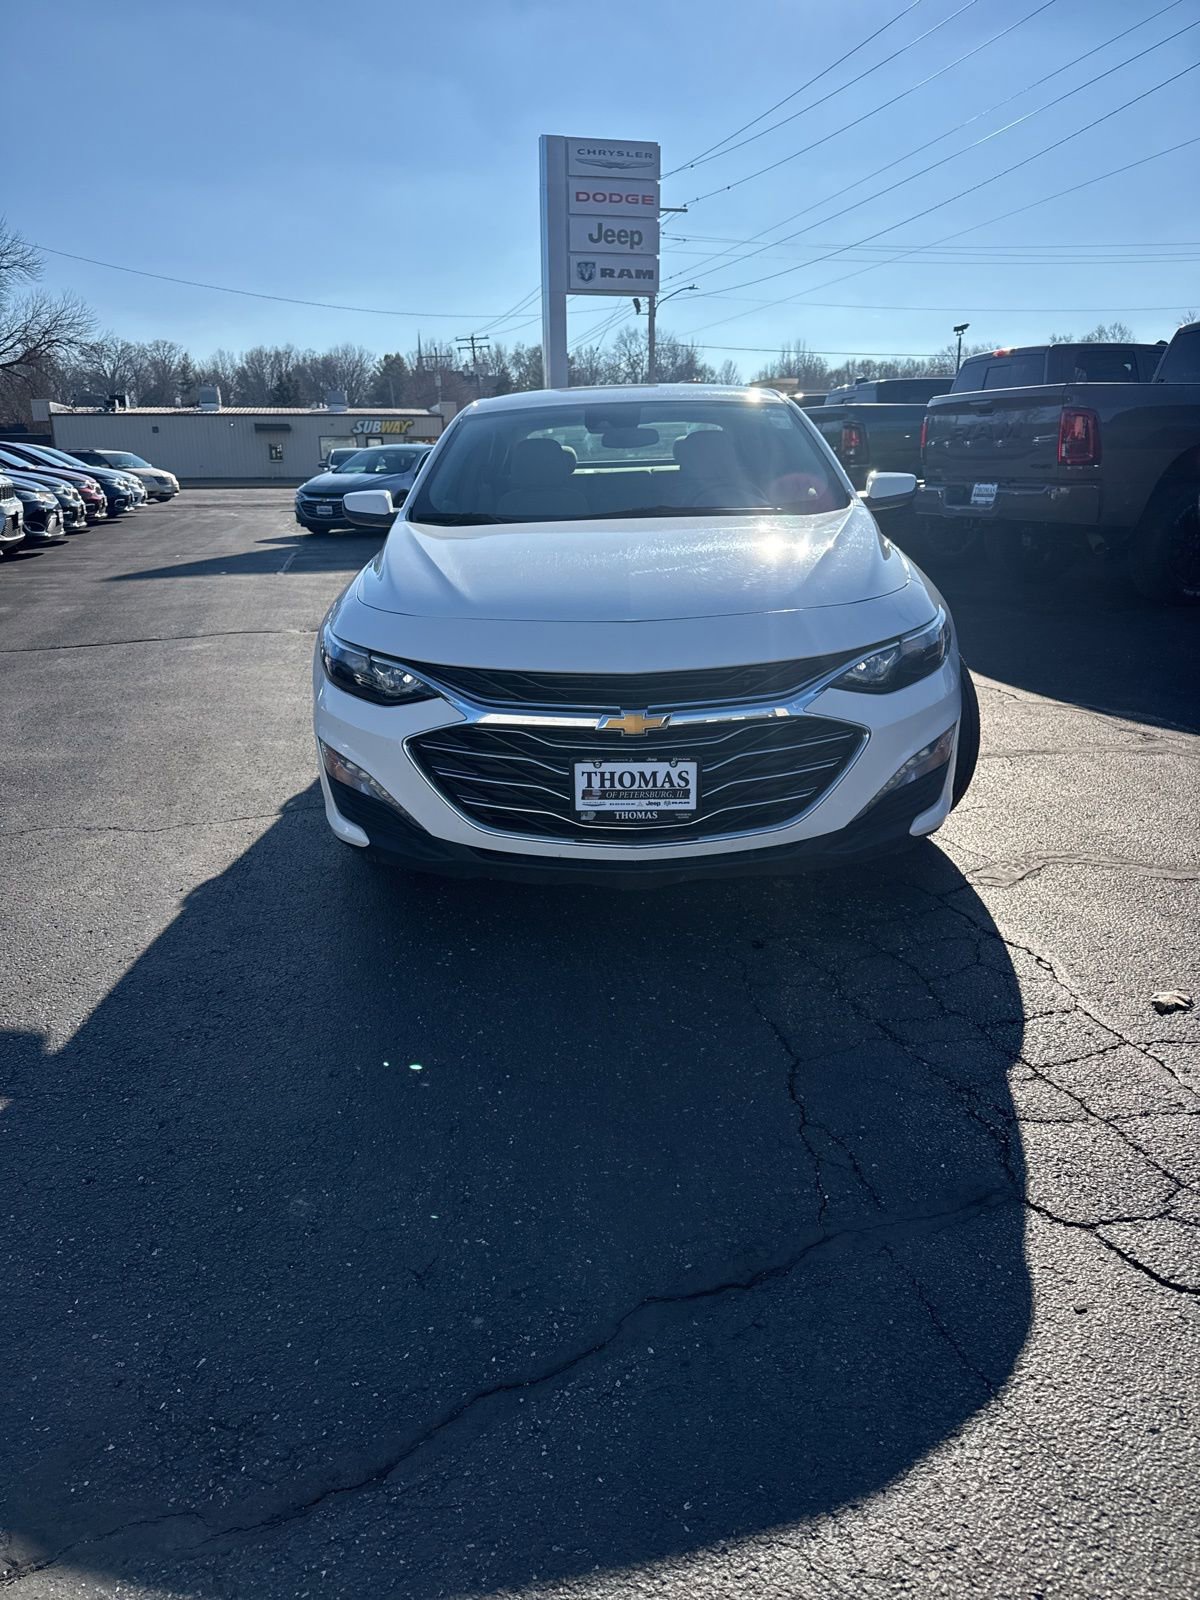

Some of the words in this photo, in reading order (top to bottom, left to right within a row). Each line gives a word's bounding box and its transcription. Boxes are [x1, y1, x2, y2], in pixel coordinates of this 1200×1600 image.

[577, 148, 653, 159] CHRYSLER
[575, 191, 655, 205] DODGE
[588, 222, 643, 250] Jeep
[600, 267, 654, 280] RAM
[353, 420, 413, 434] SUBWAY
[581, 770, 690, 789] THOMAS
[606, 791, 617, 799] OF
[618, 790, 674, 799] PETERSBURG,
[676, 790, 685, 798] IL
[614, 811, 658, 820] THOMAS
